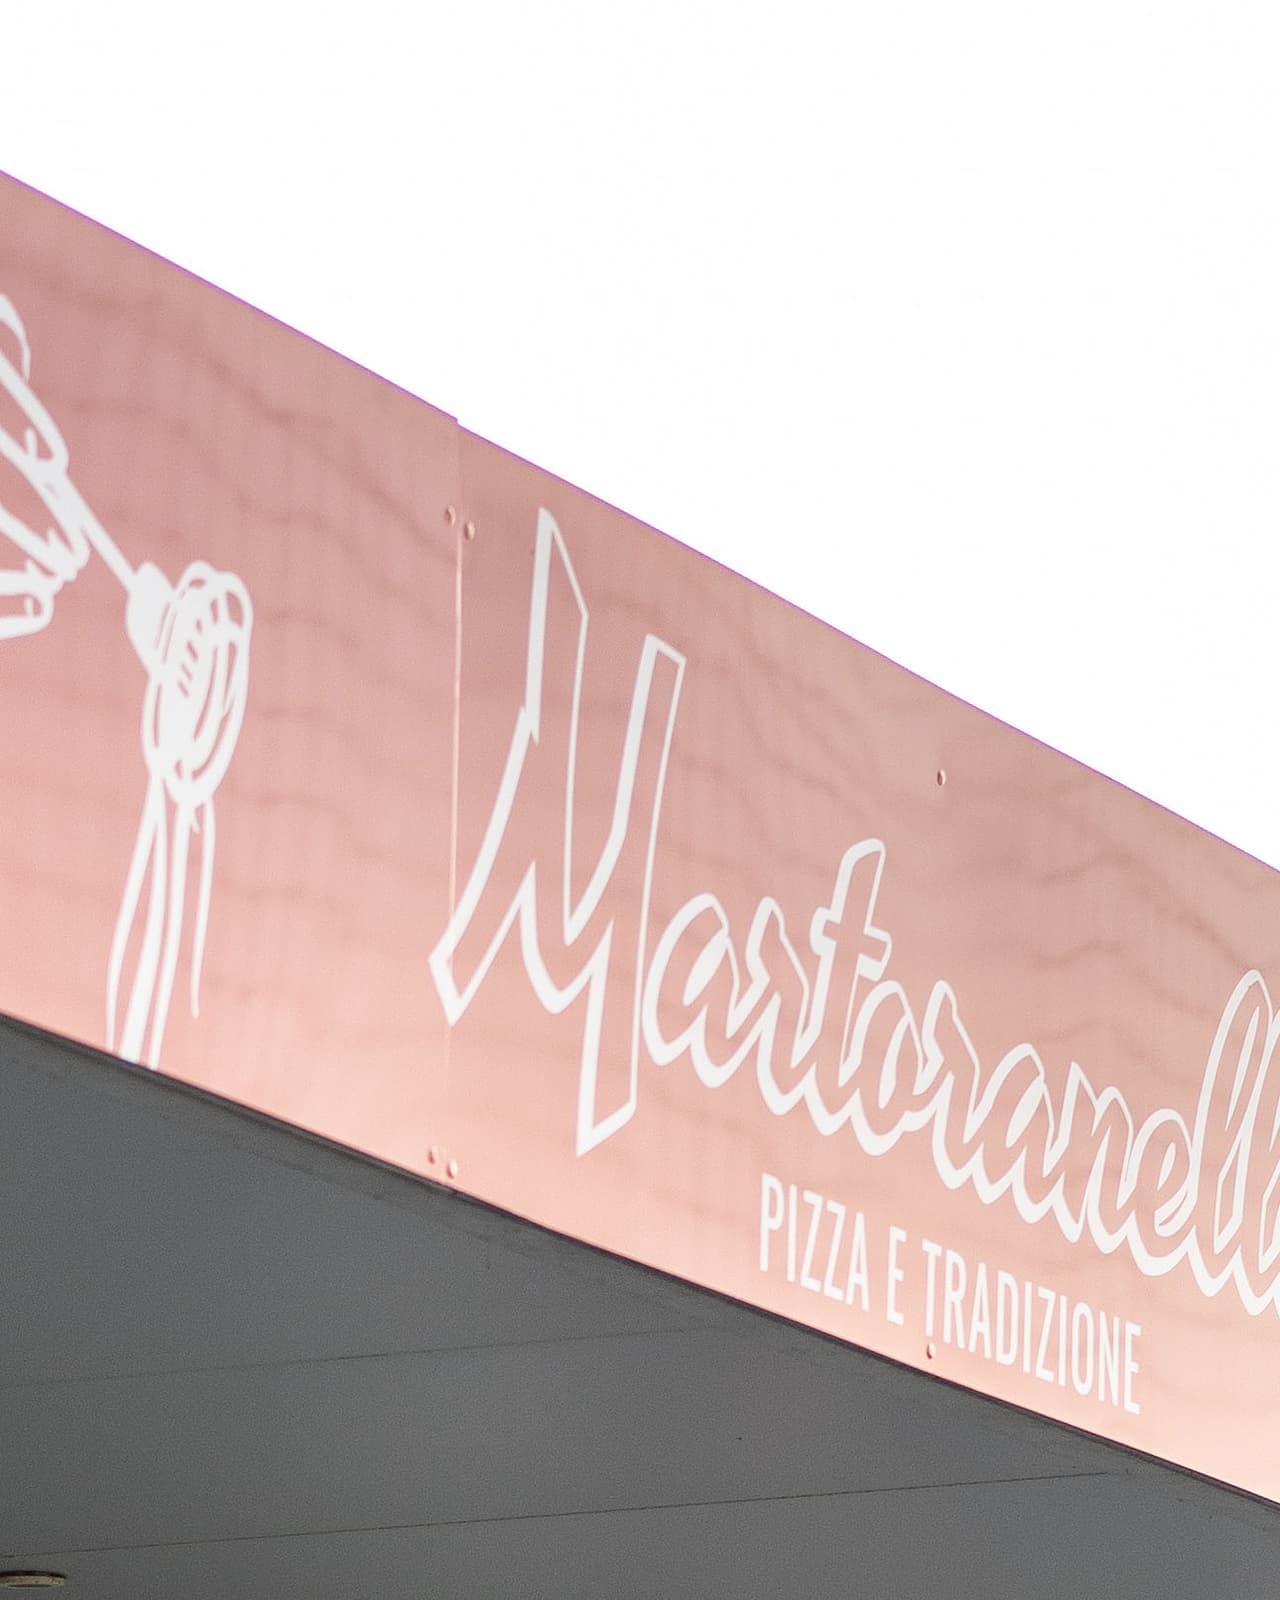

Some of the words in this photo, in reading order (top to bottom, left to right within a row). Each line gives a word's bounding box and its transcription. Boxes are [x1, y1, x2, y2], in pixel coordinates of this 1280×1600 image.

[759, 1173, 869, 1312] PIZZA
[886, 1226, 907, 1326] E
[921, 1238, 1142, 1415] TRADIZIONE
